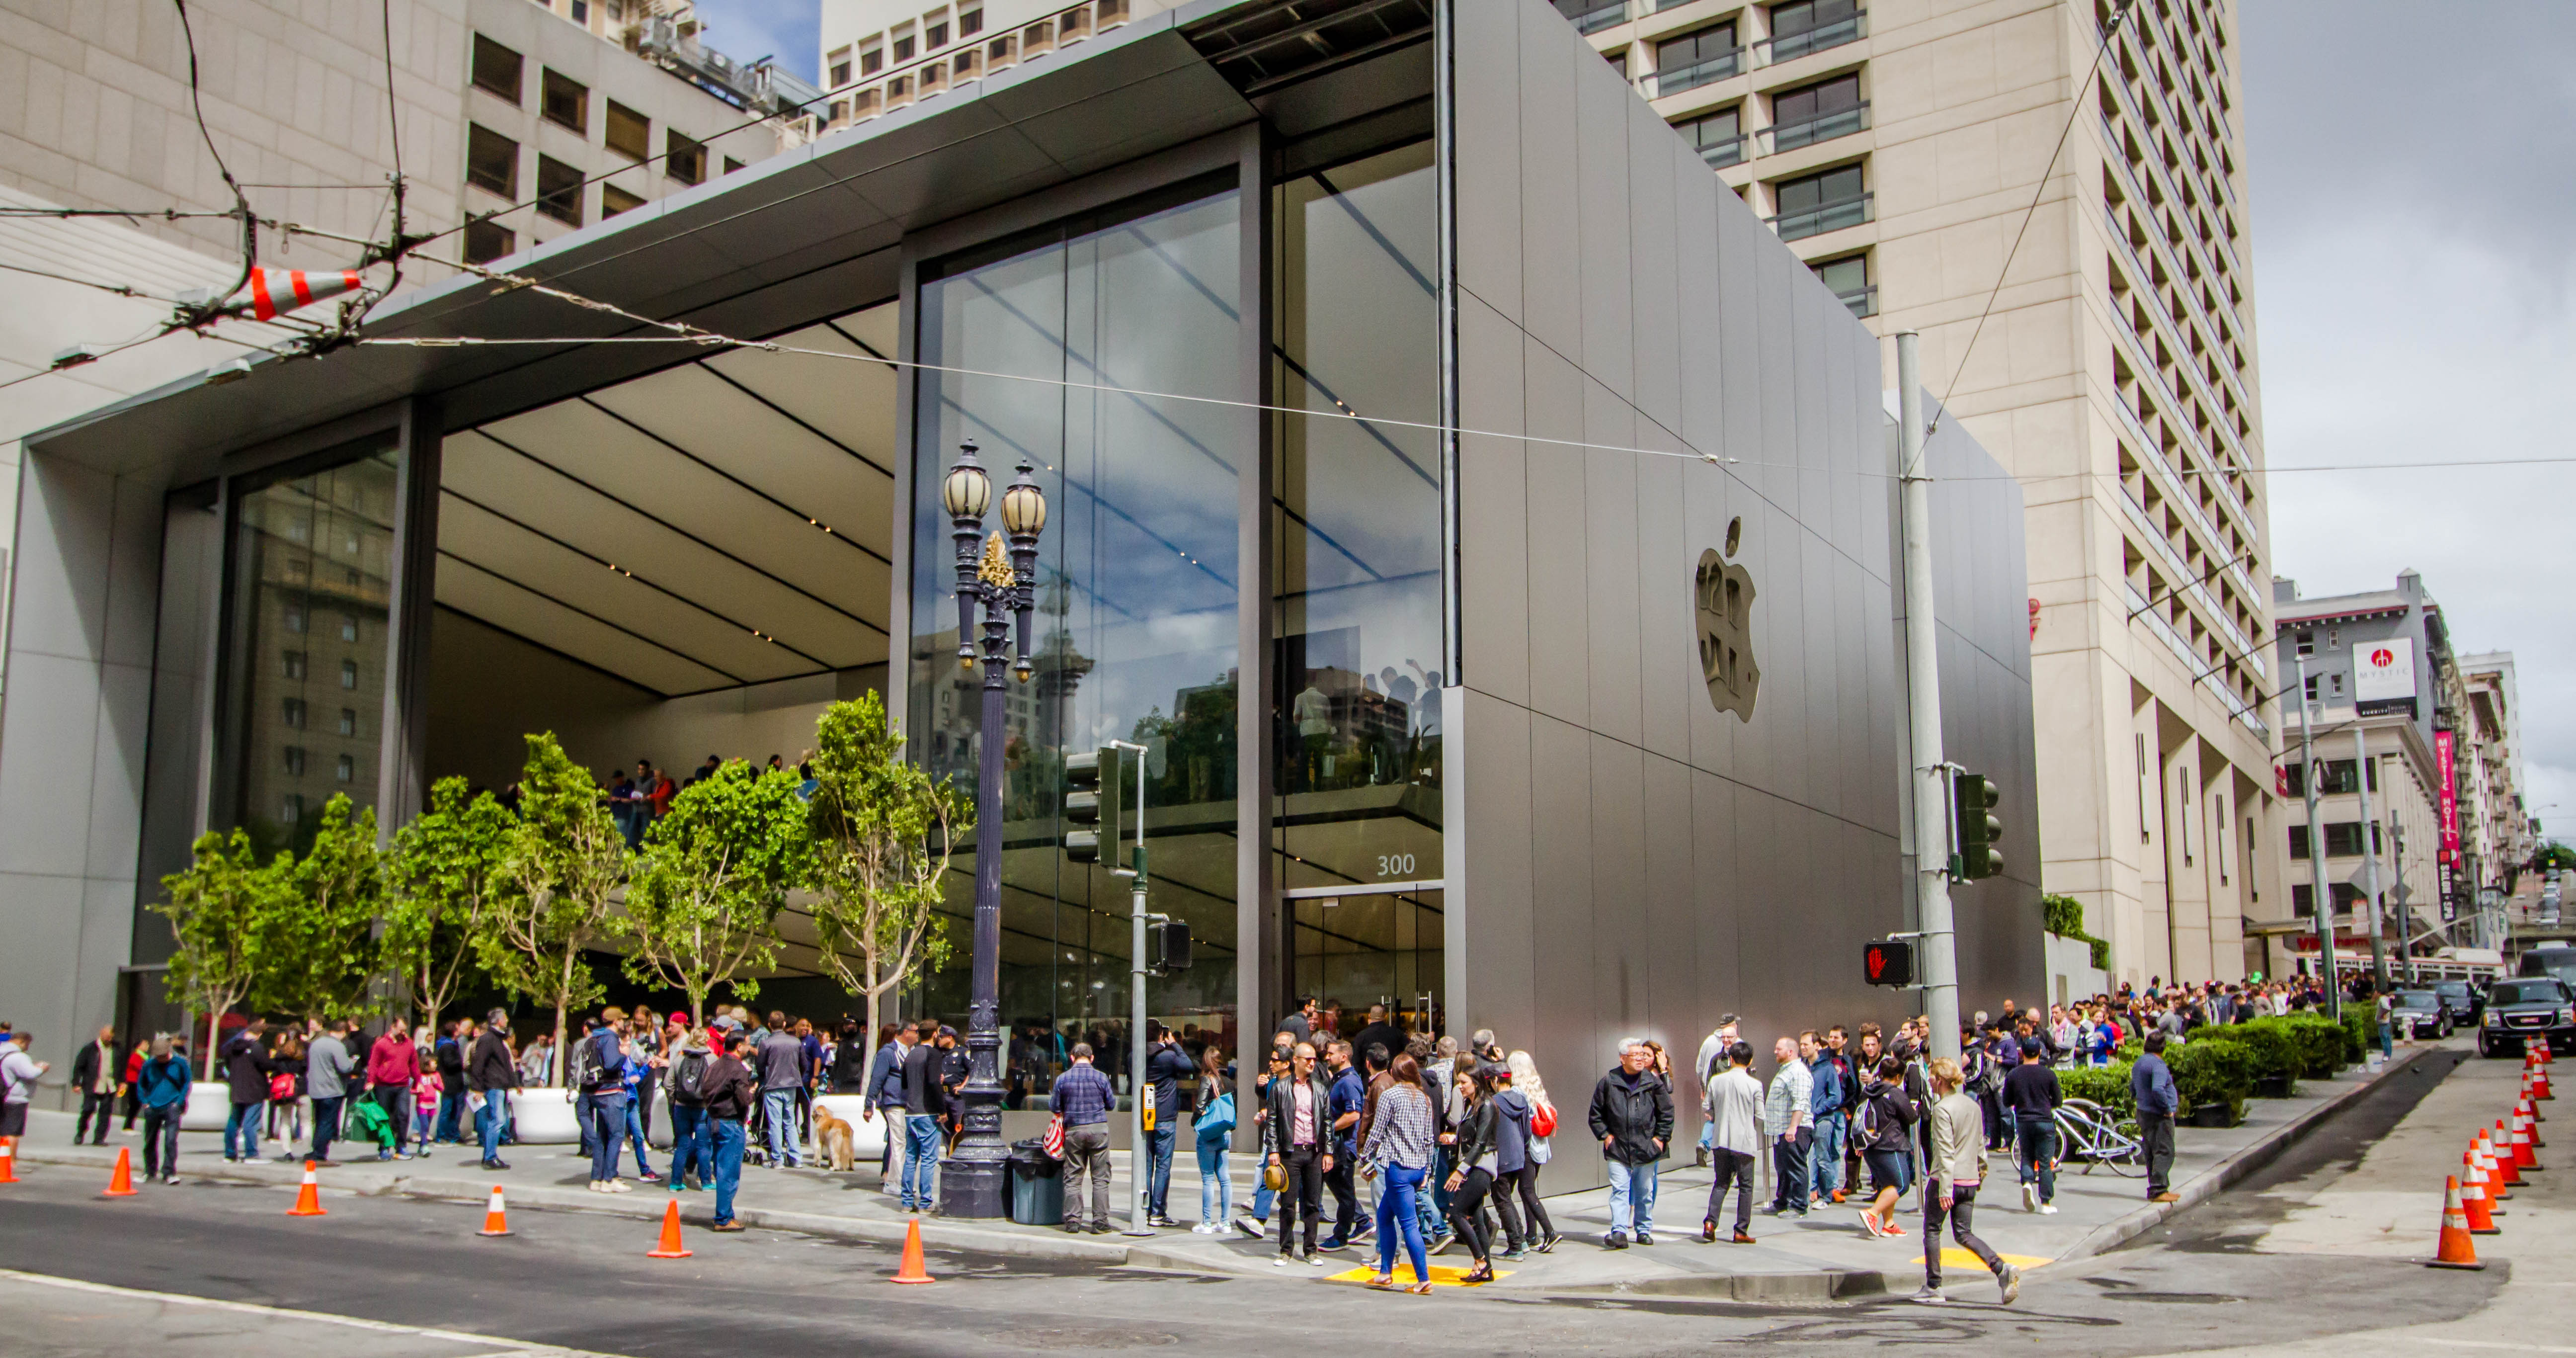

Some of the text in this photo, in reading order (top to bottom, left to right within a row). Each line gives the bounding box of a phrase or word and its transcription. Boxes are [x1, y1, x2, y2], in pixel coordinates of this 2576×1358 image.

[2360, 669, 2409, 679] MYSTIC
[2438, 739, 2452, 841] MYSTIC HOTEL
[1377, 854, 1415, 876] 300
